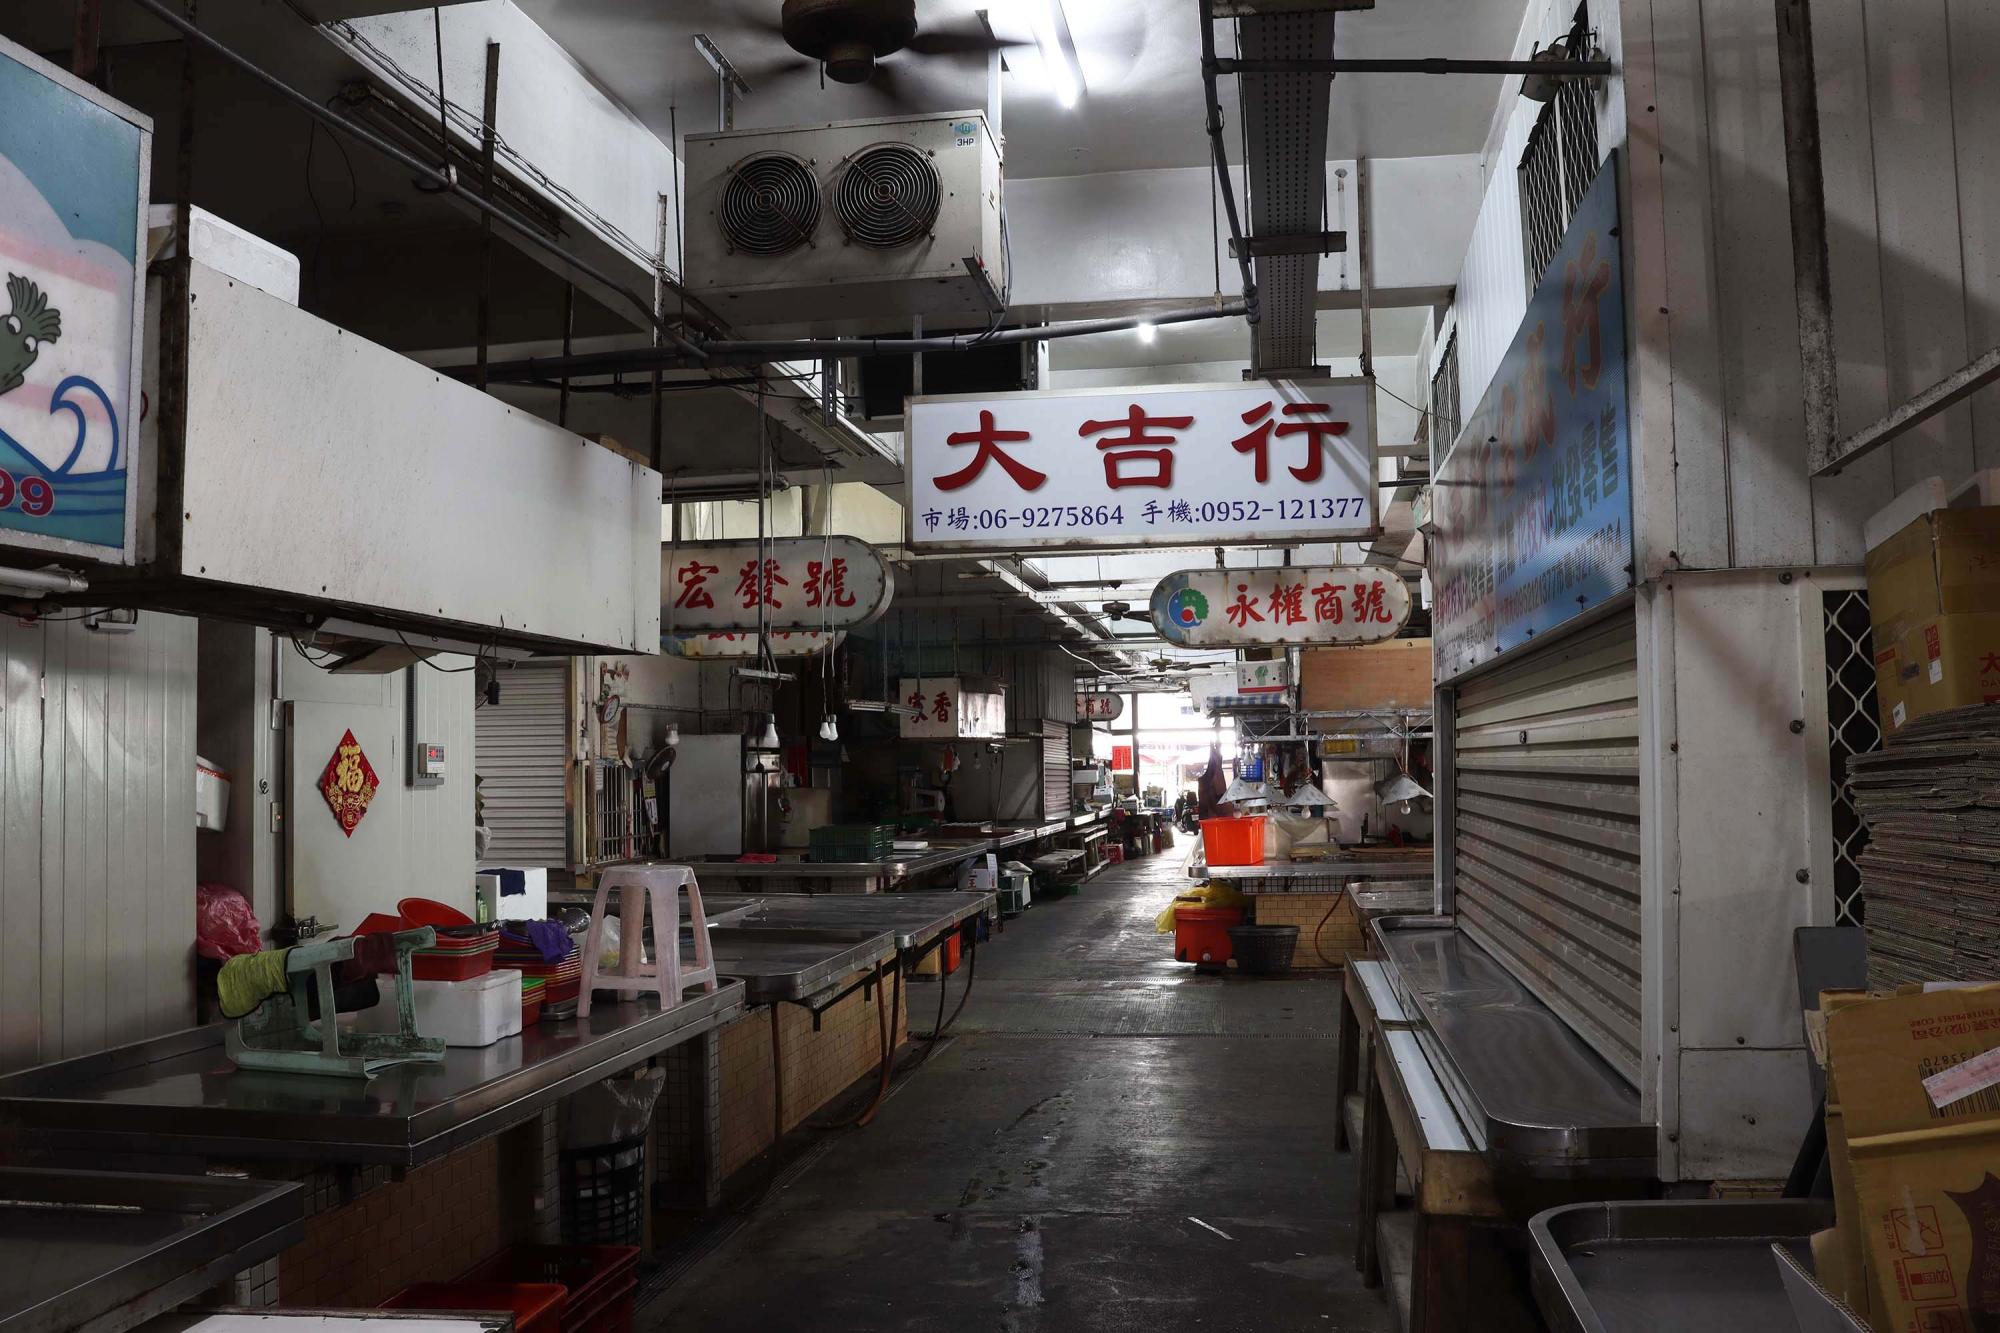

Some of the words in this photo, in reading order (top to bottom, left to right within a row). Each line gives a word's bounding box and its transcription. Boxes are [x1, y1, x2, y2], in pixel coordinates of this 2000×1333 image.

[956, 138, 974, 147] 3HP
[931, 400, 1350, 492] 大吉行
[921, 505, 1124, 532] 市場:06-9275864
[1140, 497, 1365, 526] 手機:0952-121377
[675, 558, 856, 609] 宏發號
[1225, 581, 1393, 628] 永權商號
[1076, 697, 1112, 715] 商號
